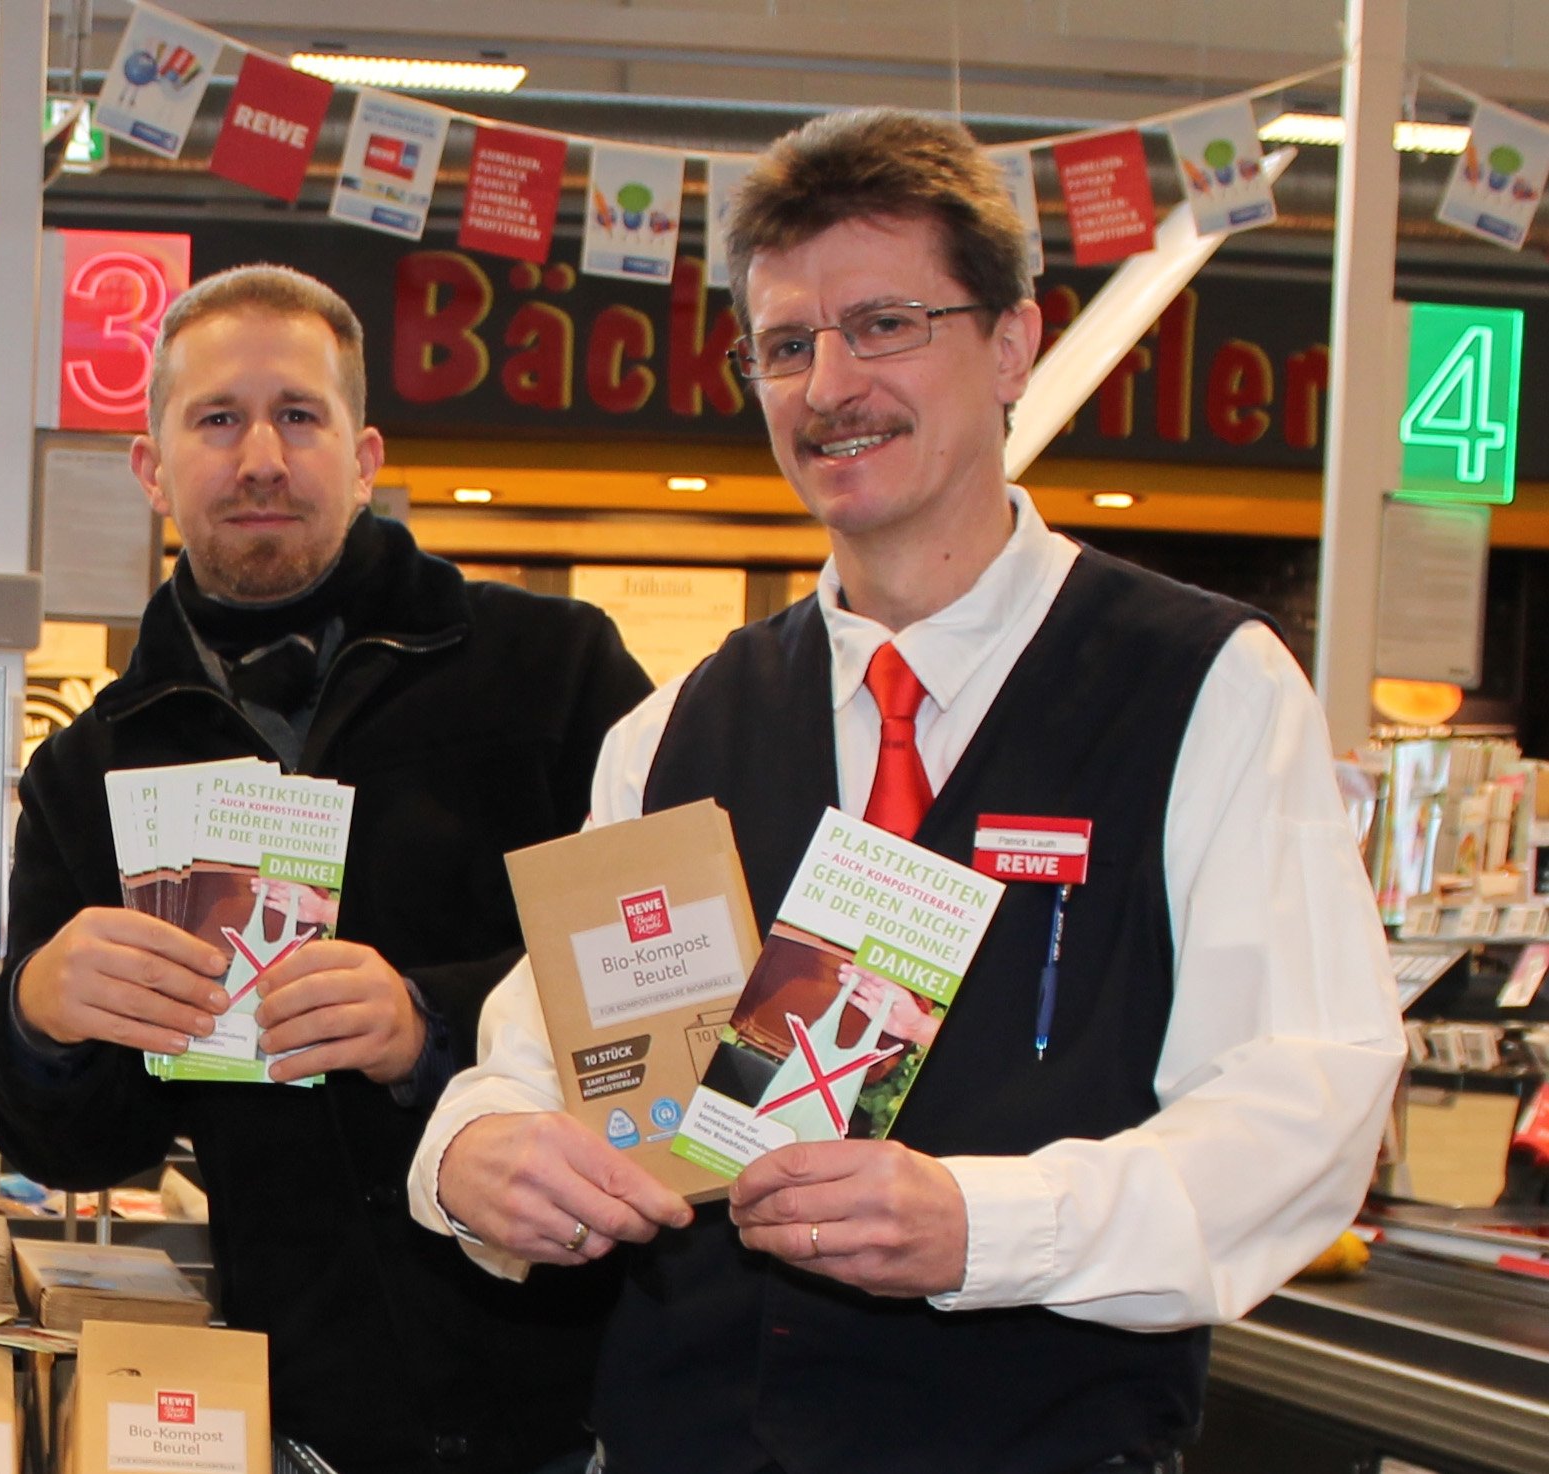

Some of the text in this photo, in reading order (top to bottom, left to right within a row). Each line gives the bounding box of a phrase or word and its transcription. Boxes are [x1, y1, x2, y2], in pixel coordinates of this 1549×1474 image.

[233, 104, 310, 149] REWE
[64, 251, 165, 415] 3
[1400, 325, 1506, 484] 4
[213, 778, 344, 811] PLASTIKTÜTEN
[220, 798, 332, 822] AUCH KOMPOSTIERBARE
[209, 808, 340, 840] GEHÖREN NICHT
[206, 825, 338, 856] IN DIE BIOTONNE!
[269, 858, 336, 882] DANKE!
[829, 827, 988, 910] PLASTIKTÜTEN
[996, 853, 1060, 876] REWE
[832, 853, 967, 920] AUCH KOMPOSTIERBARE
[626, 897, 663, 918] REWE
[813, 863, 971, 943] GEHÖREN NICHT
[802, 883, 961, 964] IN DIE BIOTONNE!
[602, 934, 710, 974] Bio-Kompost
[633, 960, 689, 988] Beutel
[867, 945, 950, 996] DANKE!
[695, 1030, 710, 1043] 10
[584, 1045, 633, 1067] 10 STÜCK
[702, 1100, 746, 1127] Information
[160, 1396, 192, 1407] REWE
[129, 1424, 224, 1443] Bio-Kompost
[153, 1441, 201, 1455] Beutel
